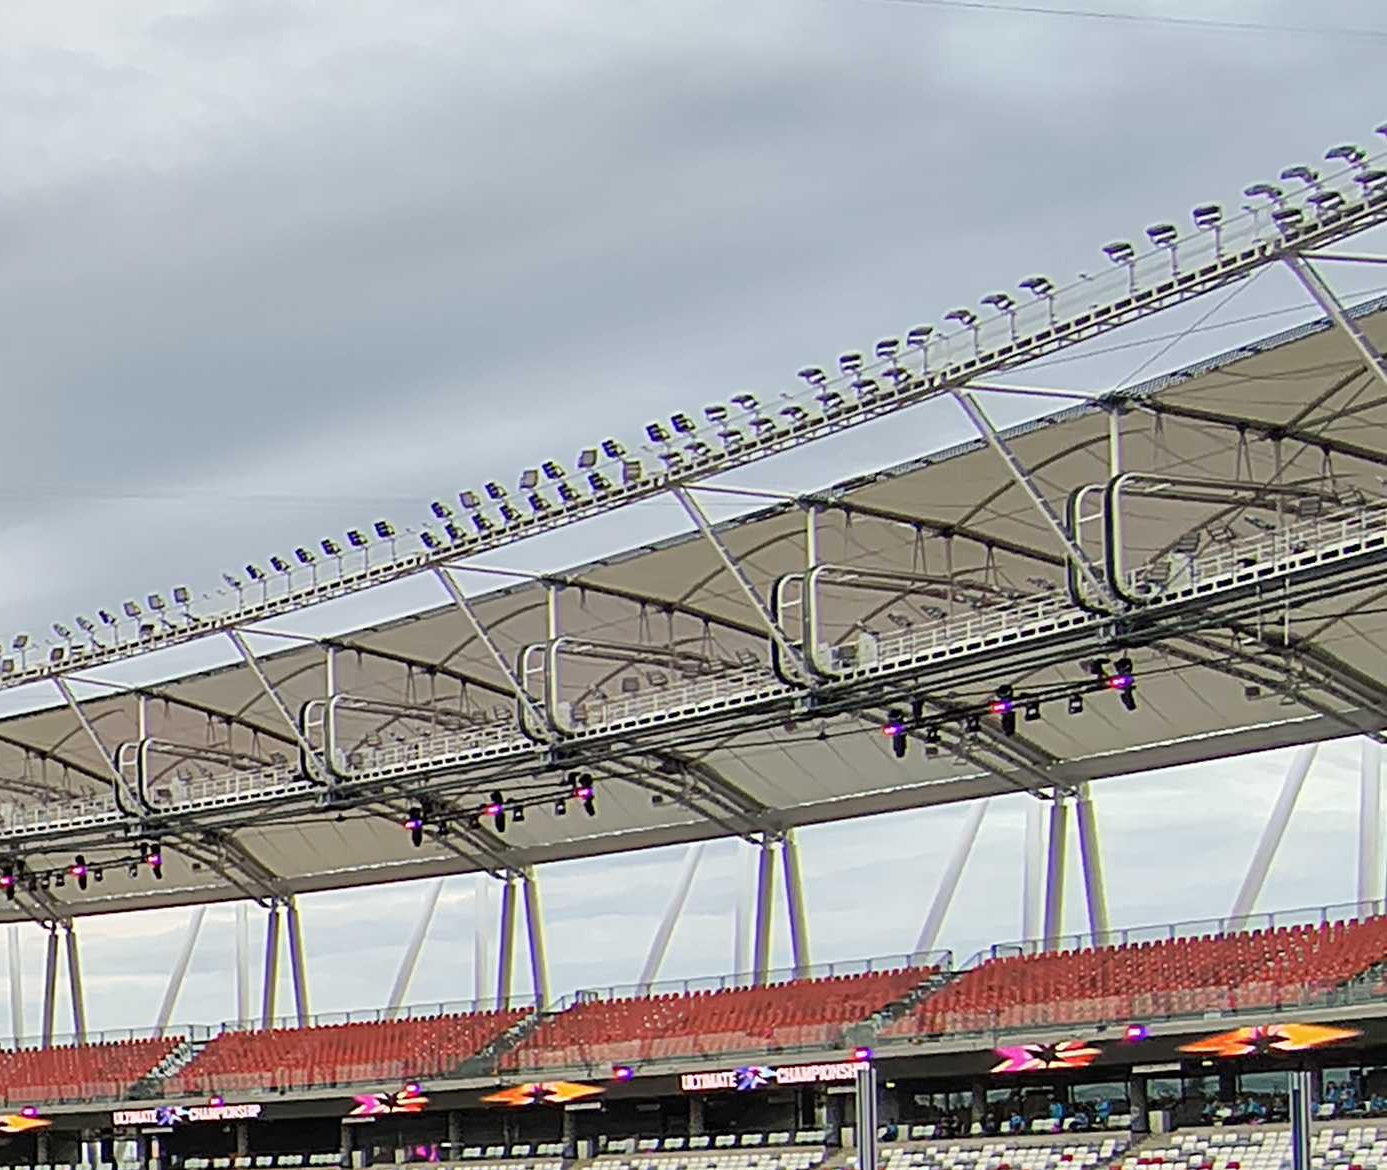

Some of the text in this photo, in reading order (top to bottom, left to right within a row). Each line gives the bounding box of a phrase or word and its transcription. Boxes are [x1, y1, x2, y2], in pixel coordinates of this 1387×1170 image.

[681, 1071, 737, 1091] ULTIMATE
[113, 1104, 261, 1125] ULTIMATE CHAMPIONSHIP
